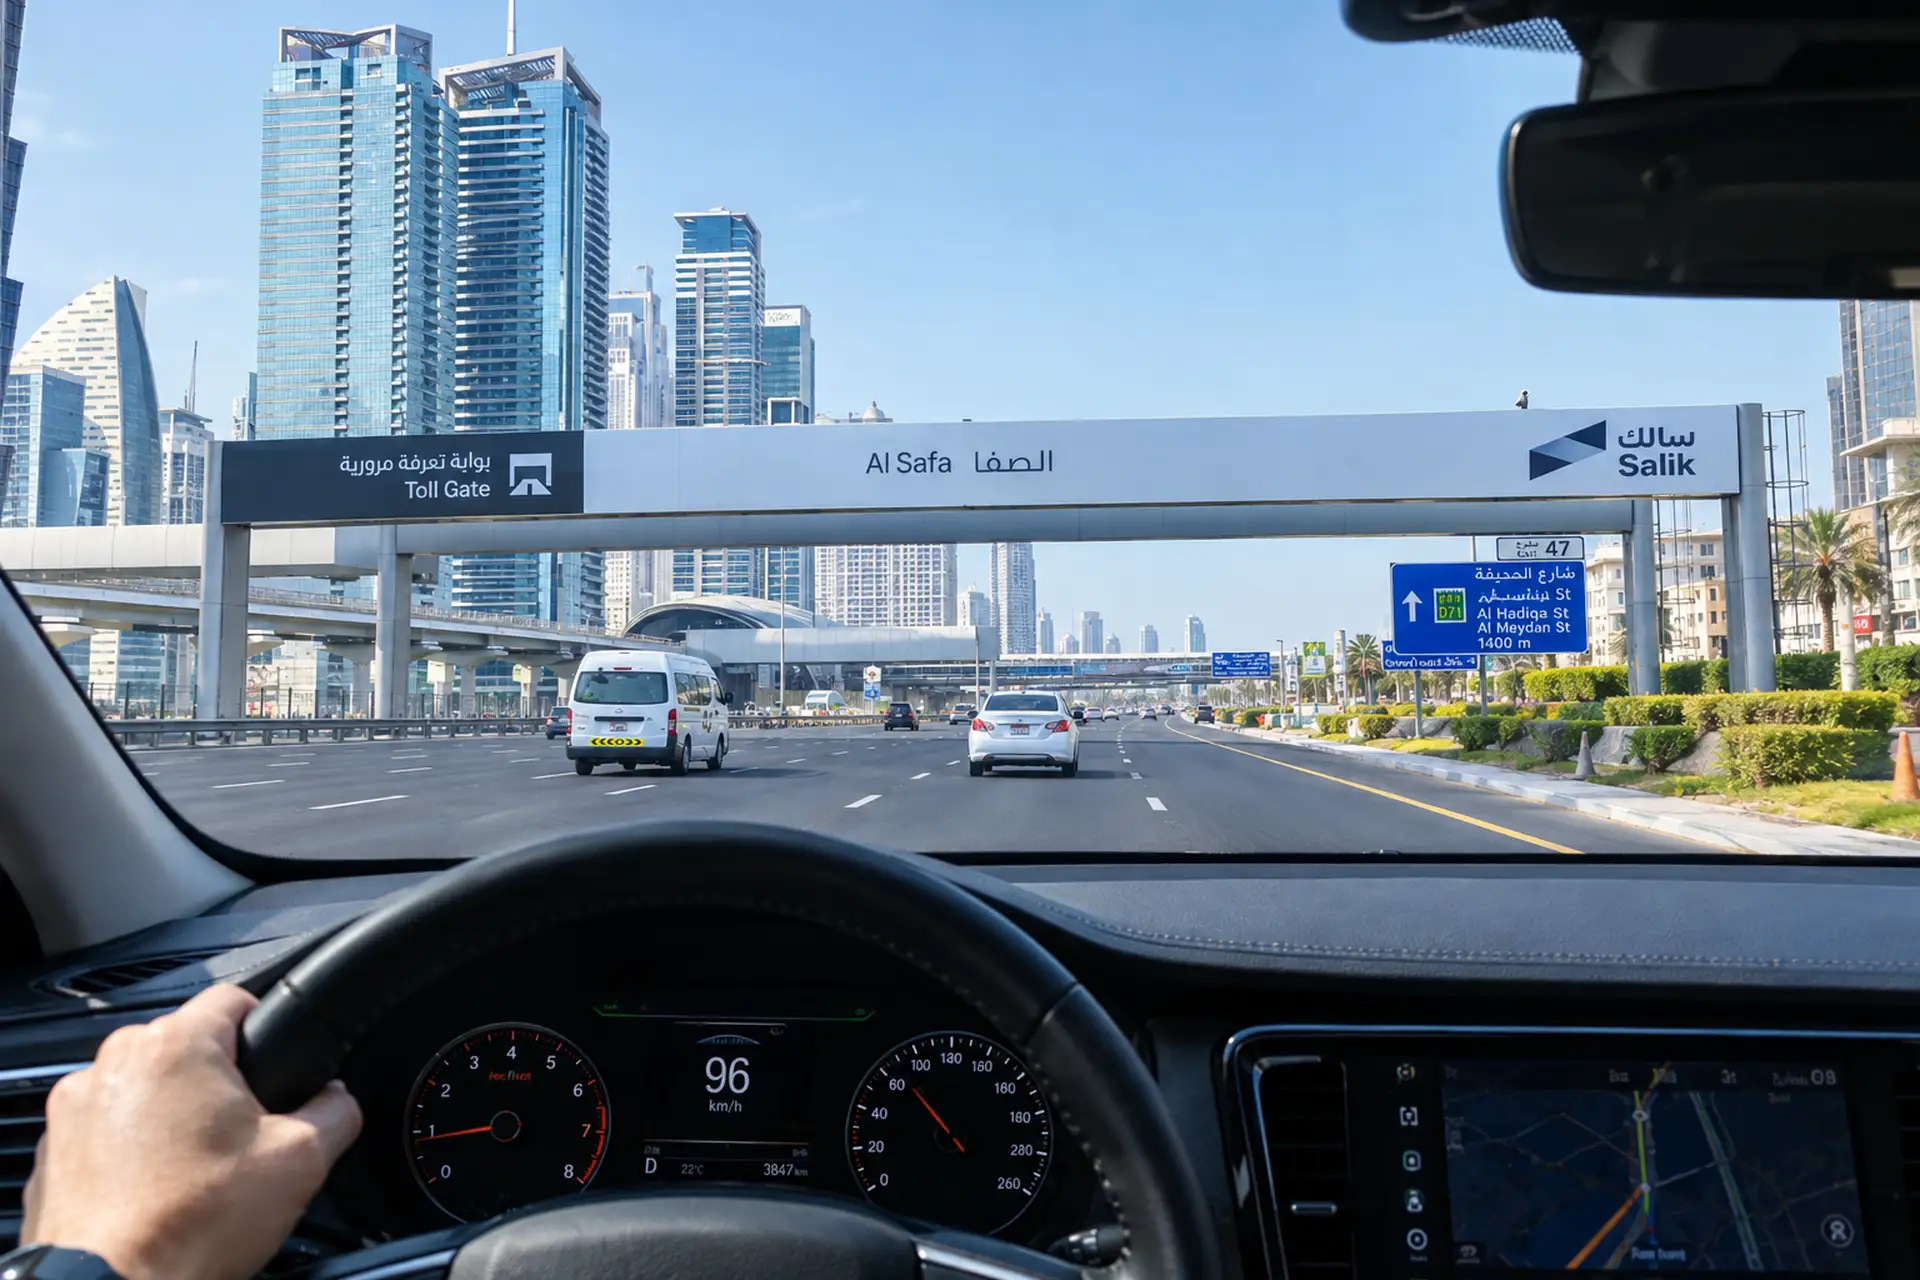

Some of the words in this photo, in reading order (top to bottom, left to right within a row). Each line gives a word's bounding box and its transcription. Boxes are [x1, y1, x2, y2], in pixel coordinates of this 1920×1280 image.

[1618, 427, 1695, 448] سالك
[340, 455, 394, 476] مرورية
[398, 454, 446, 474] تعرفة
[866, 452, 889, 474] Al
[896, 451, 952, 473] Safa
[975, 449, 1053, 472] الصفا
[1618, 453, 1696, 477] Salik
[405, 481, 438, 499] Toll
[444, 480, 491, 498] Gate
[1545, 540, 1570, 556] 47
[1556, 587, 1571, 601] St
[1439, 606, 1462, 619] D71
[1477, 607, 1491, 619] Al
[1553, 607, 1569, 619] St
[1477, 622, 1491, 634] Al
[1497, 621, 1550, 636] Meydan
[1556, 621, 1571, 633] St
[1477, 637, 1512, 649] 1400
[1518, 639, 1531, 649] m
[506, 1046, 517, 1060] 4
[469, 1056, 479, 1070] 3
[546, 1055, 556, 1070] 5
[911, 1059, 931, 1071] 100
[705, 1056, 750, 1094] 96
[441, 1084, 451, 1098] 2
[573, 1083, 583, 1097] 6
[709, 1100, 742, 1113] km/h
[871, 1107, 888, 1119] 40
[429, 1125, 435, 1138] 1
[582, 1123, 592, 1138] 7
[868, 1140, 885, 1153] 20
[441, 1165, 451, 1179] 0
[564, 1164, 574, 1178] 8
[645, 1157, 657, 1174] D
[763, 1163, 793, 1177] 3847
[880, 1174, 889, 1187] 0
[997, 1177, 1020, 1190] 260
